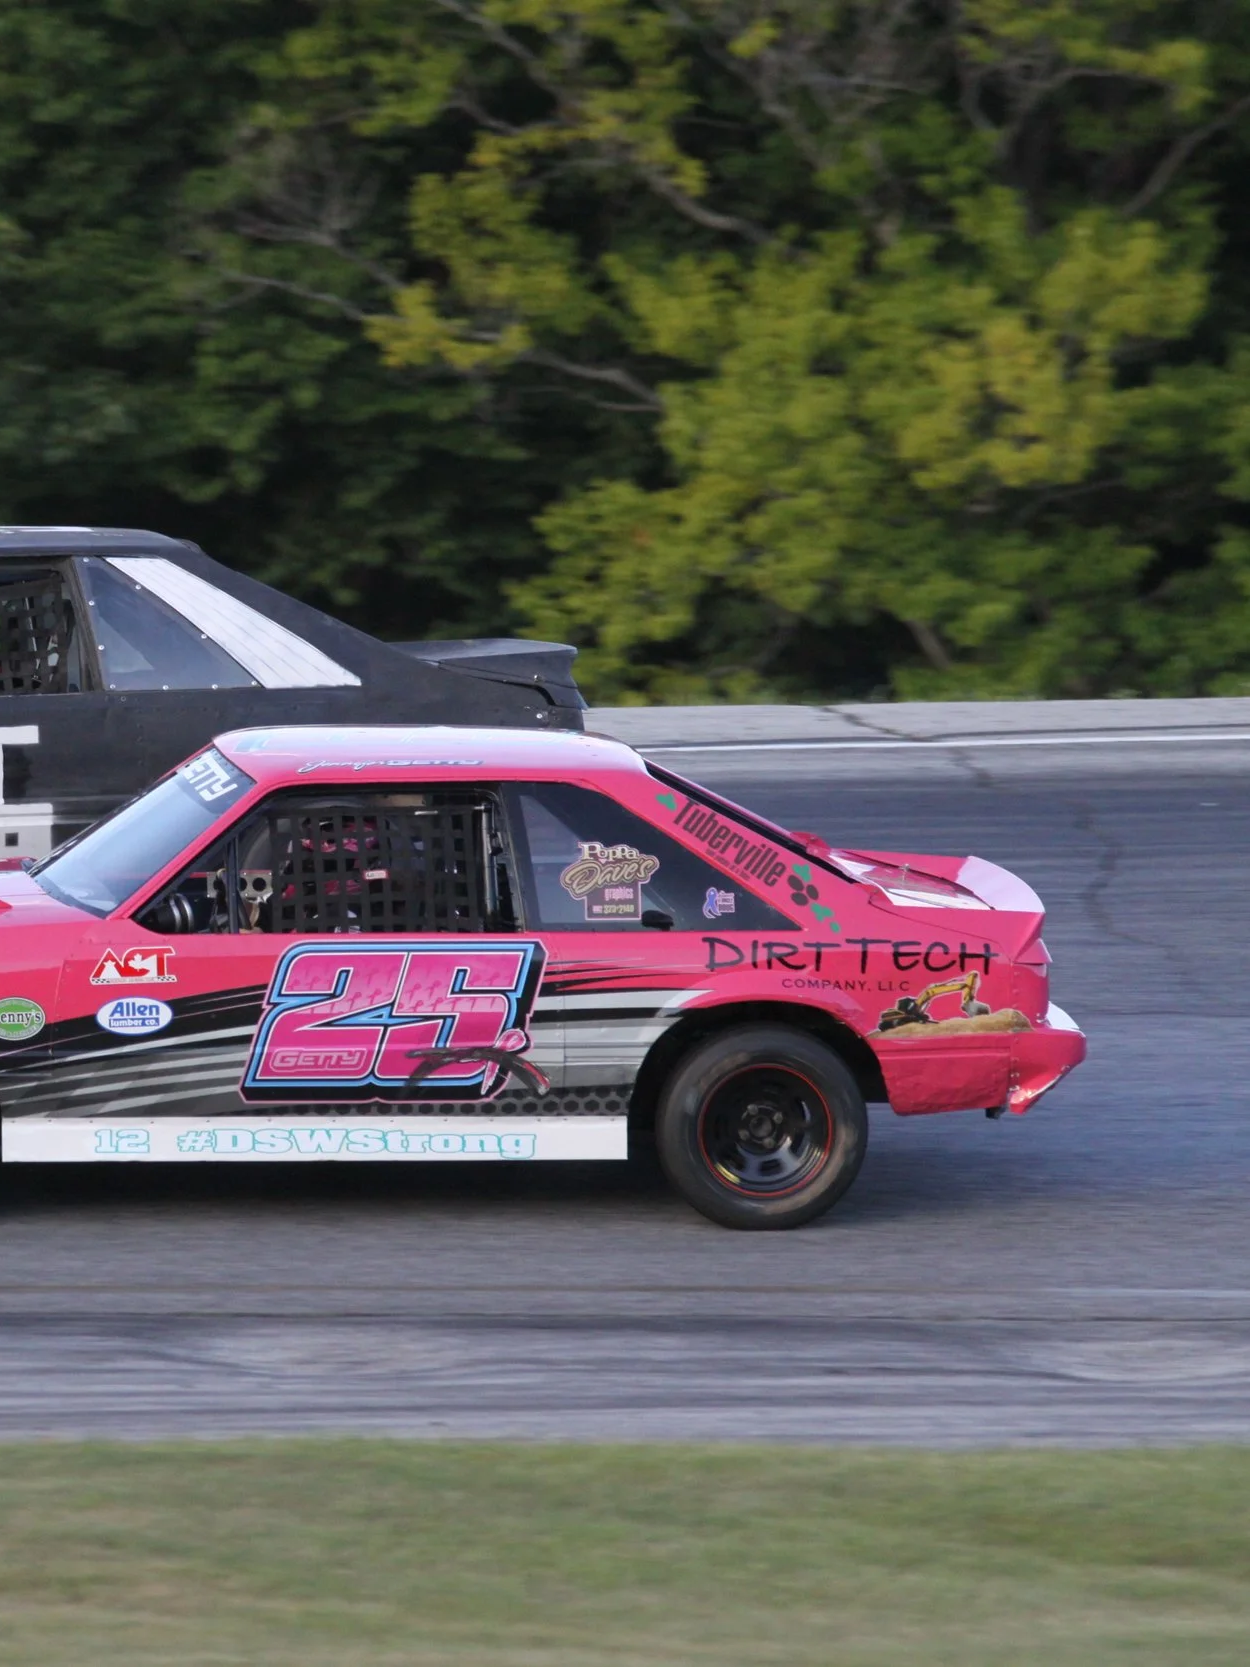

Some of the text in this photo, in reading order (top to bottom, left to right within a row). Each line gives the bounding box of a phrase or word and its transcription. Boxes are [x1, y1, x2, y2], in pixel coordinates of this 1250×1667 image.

[181, 750, 239, 802] ETTY
[672, 797, 787, 888] Tuberville
[564, 858, 656, 897] Dave's
[701, 936, 1000, 976] DIRT TECH
[109, 1001, 160, 1018] Allen
[110, 1017, 159, 1028] lumber co.
[242, 940, 547, 1098] 25
[94, 1128, 537, 1161] 12 #DSWStrong
